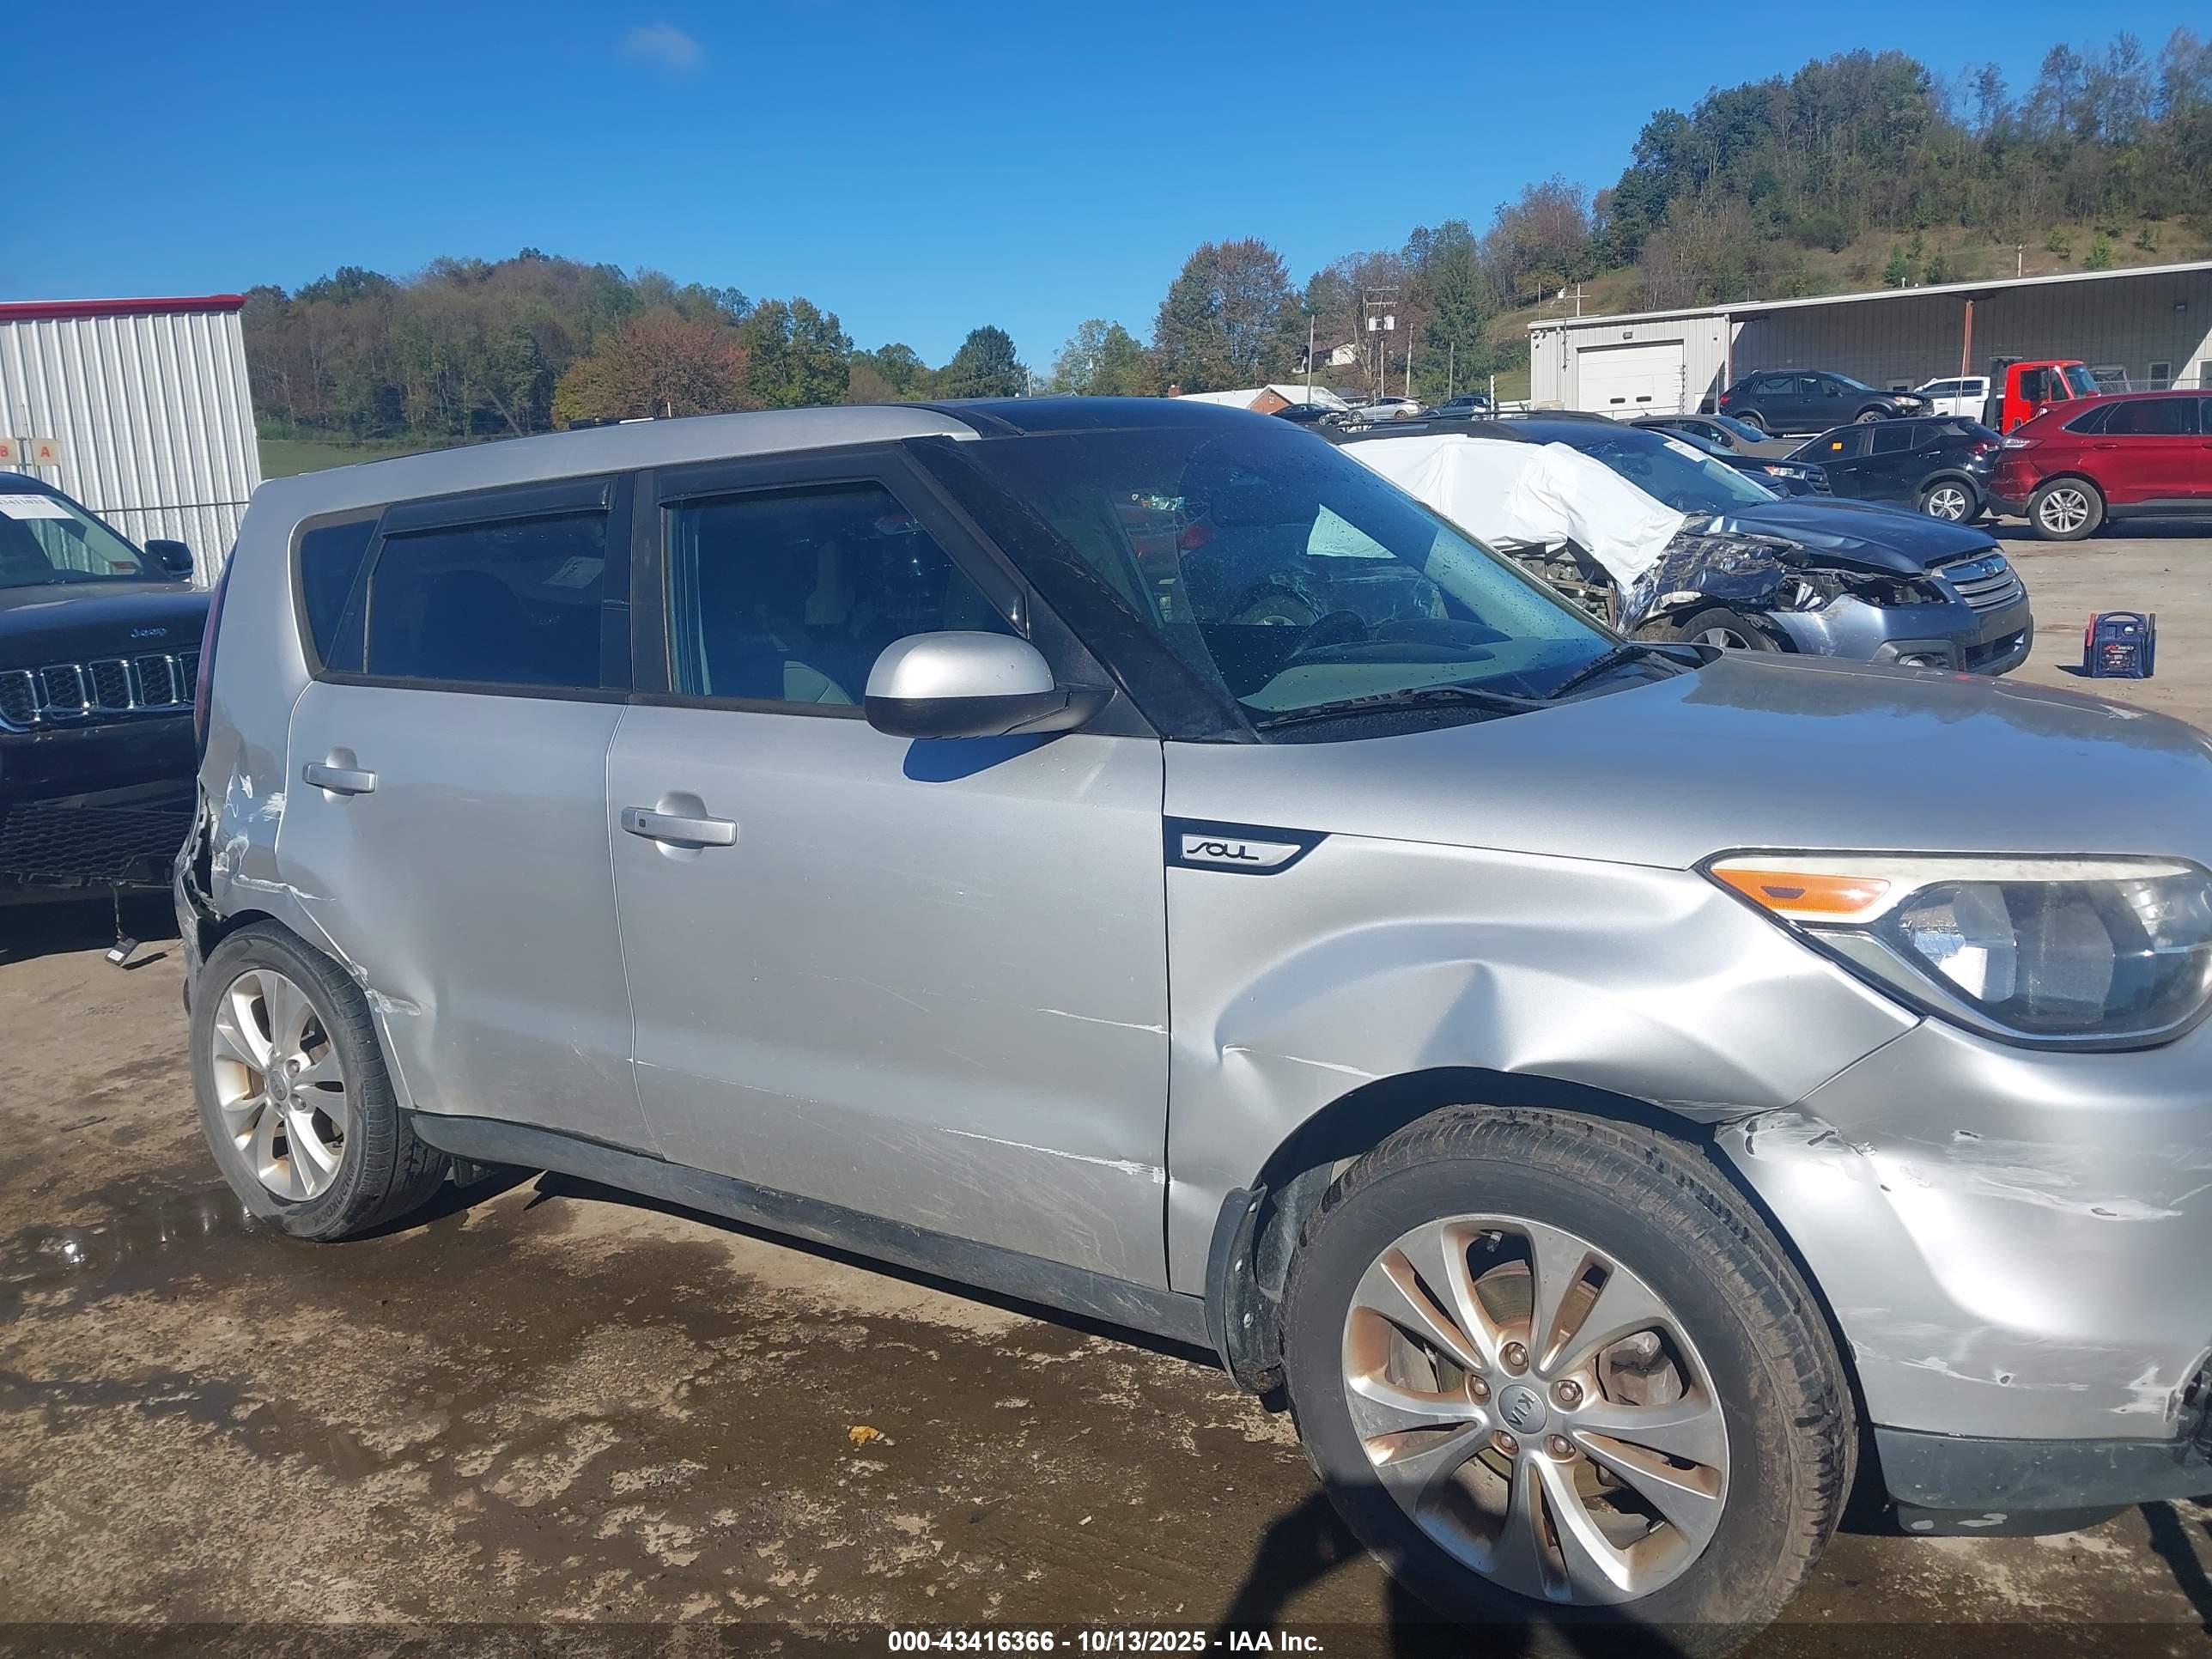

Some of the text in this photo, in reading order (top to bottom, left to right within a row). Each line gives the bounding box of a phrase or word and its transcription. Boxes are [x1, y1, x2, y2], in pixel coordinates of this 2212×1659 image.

[40, 446, 51, 458] A
[131, 628, 167, 638] Jeep
[1186, 842, 1260, 861] SOUL
[1508, 1392, 1535, 1426] KIA
